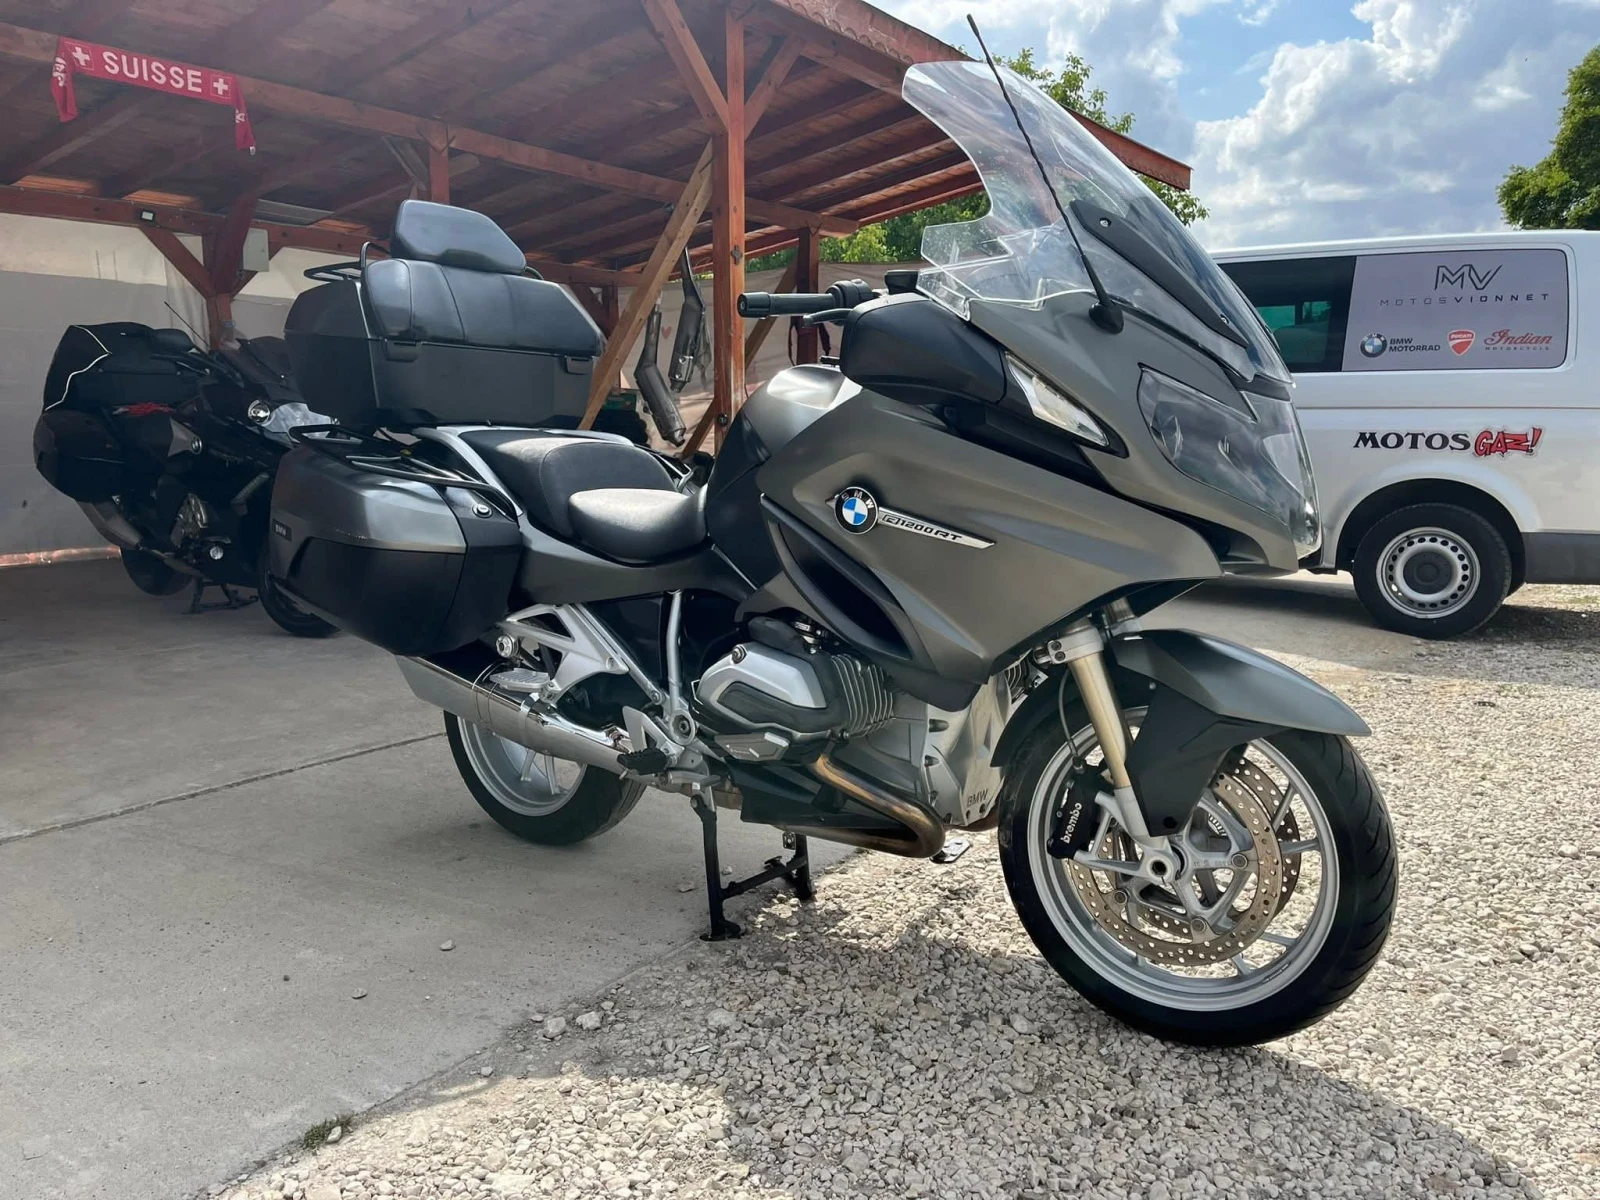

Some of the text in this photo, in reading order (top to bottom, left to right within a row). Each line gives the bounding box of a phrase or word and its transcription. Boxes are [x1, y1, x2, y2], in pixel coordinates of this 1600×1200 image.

[102, 51, 202, 93] SUISSE
[1434, 264, 1503, 290] MV
[1389, 337, 1414, 345] BMW
[1483, 329, 1552, 345] Indian
[1388, 344, 1441, 352] MOTORRAD
[1353, 432, 1471, 451] MOTOS
[967, 788, 989, 807] BMW
[1060, 802, 1083, 844] brembo
